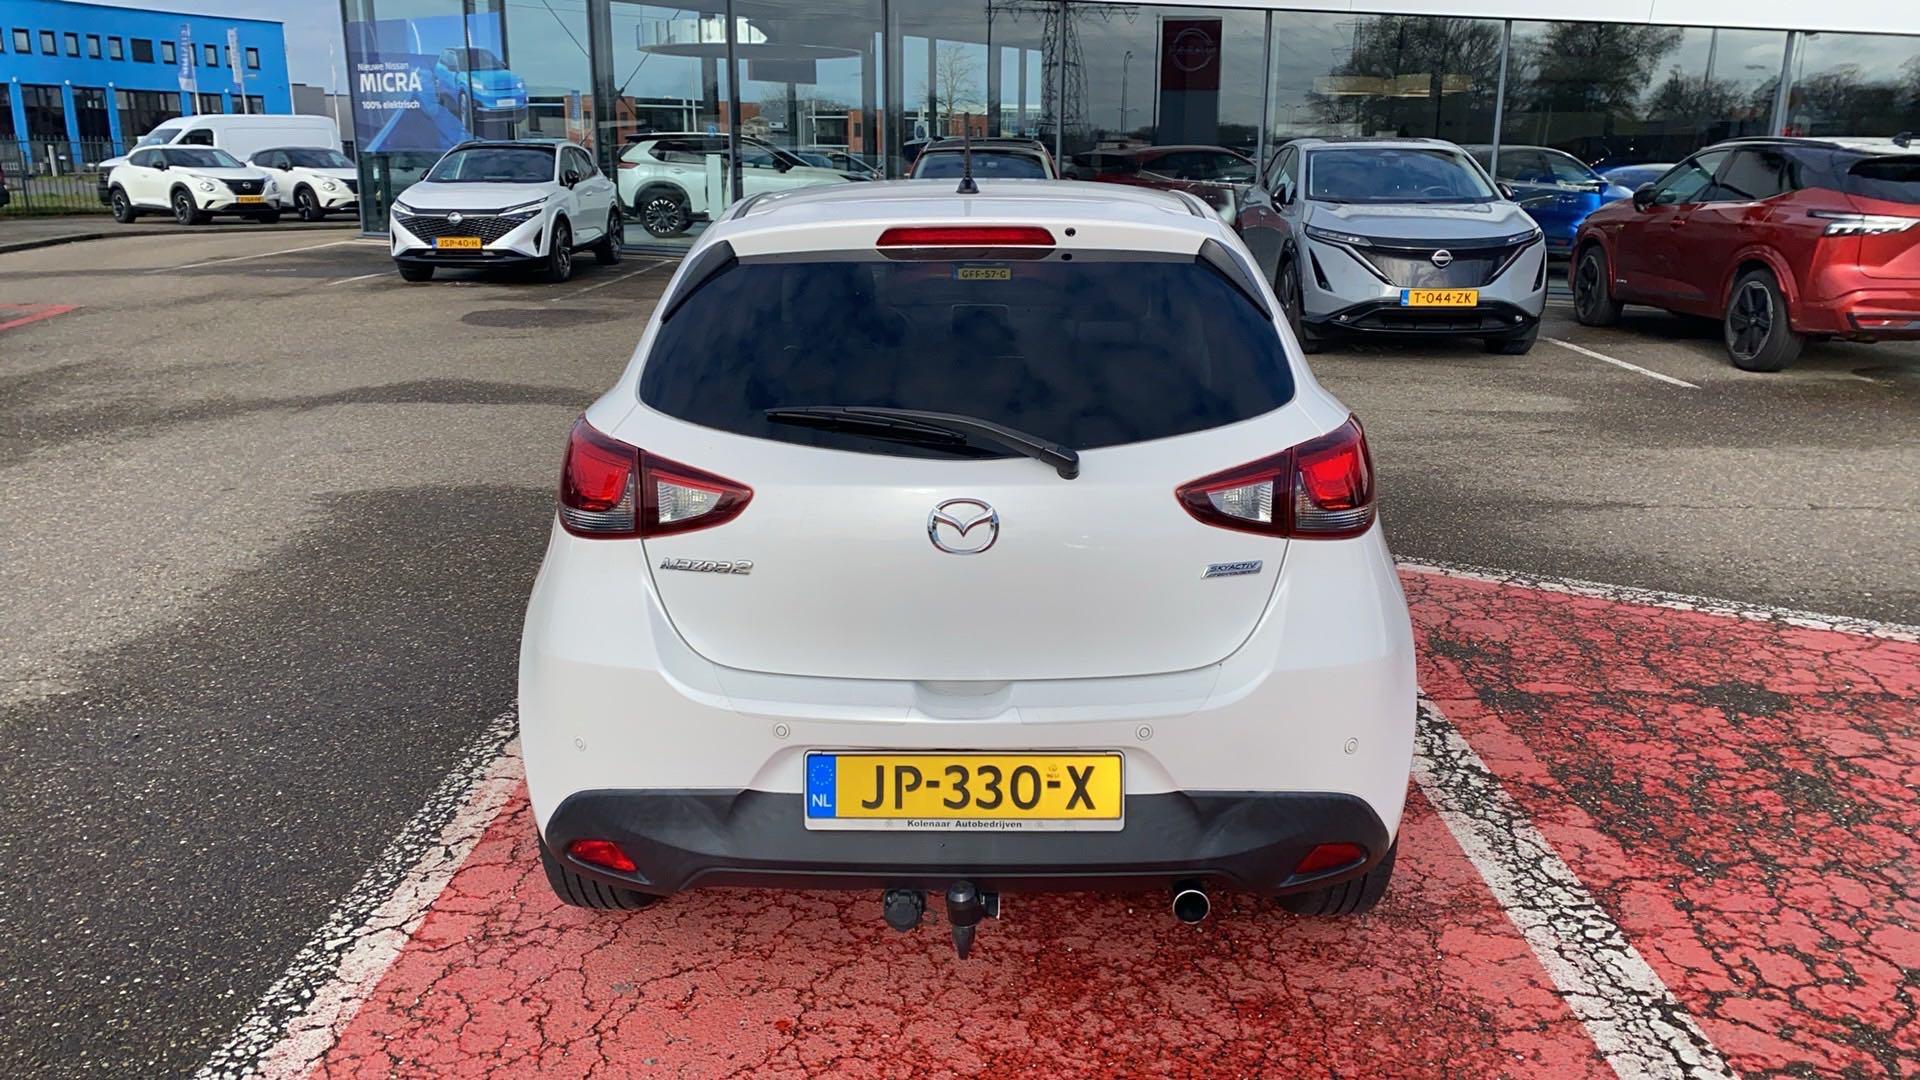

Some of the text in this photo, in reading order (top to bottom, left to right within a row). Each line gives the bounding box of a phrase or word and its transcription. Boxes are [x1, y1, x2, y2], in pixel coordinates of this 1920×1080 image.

[360, 72, 422, 93] MICRA
[362, 100, 420, 110] 100% elektrisch
[440, 239, 478, 248] JSP-40-H
[961, 270, 1007, 279] GFF-57-G
[1414, 292, 1472, 304] T-044-ZK
[1209, 561, 1260, 573] SKYACTIV
[861, 765, 1096, 810] JP-330-X
[811, 793, 832, 808] NL
[906, 819, 1023, 830] Kolenaar Autobedrijven
